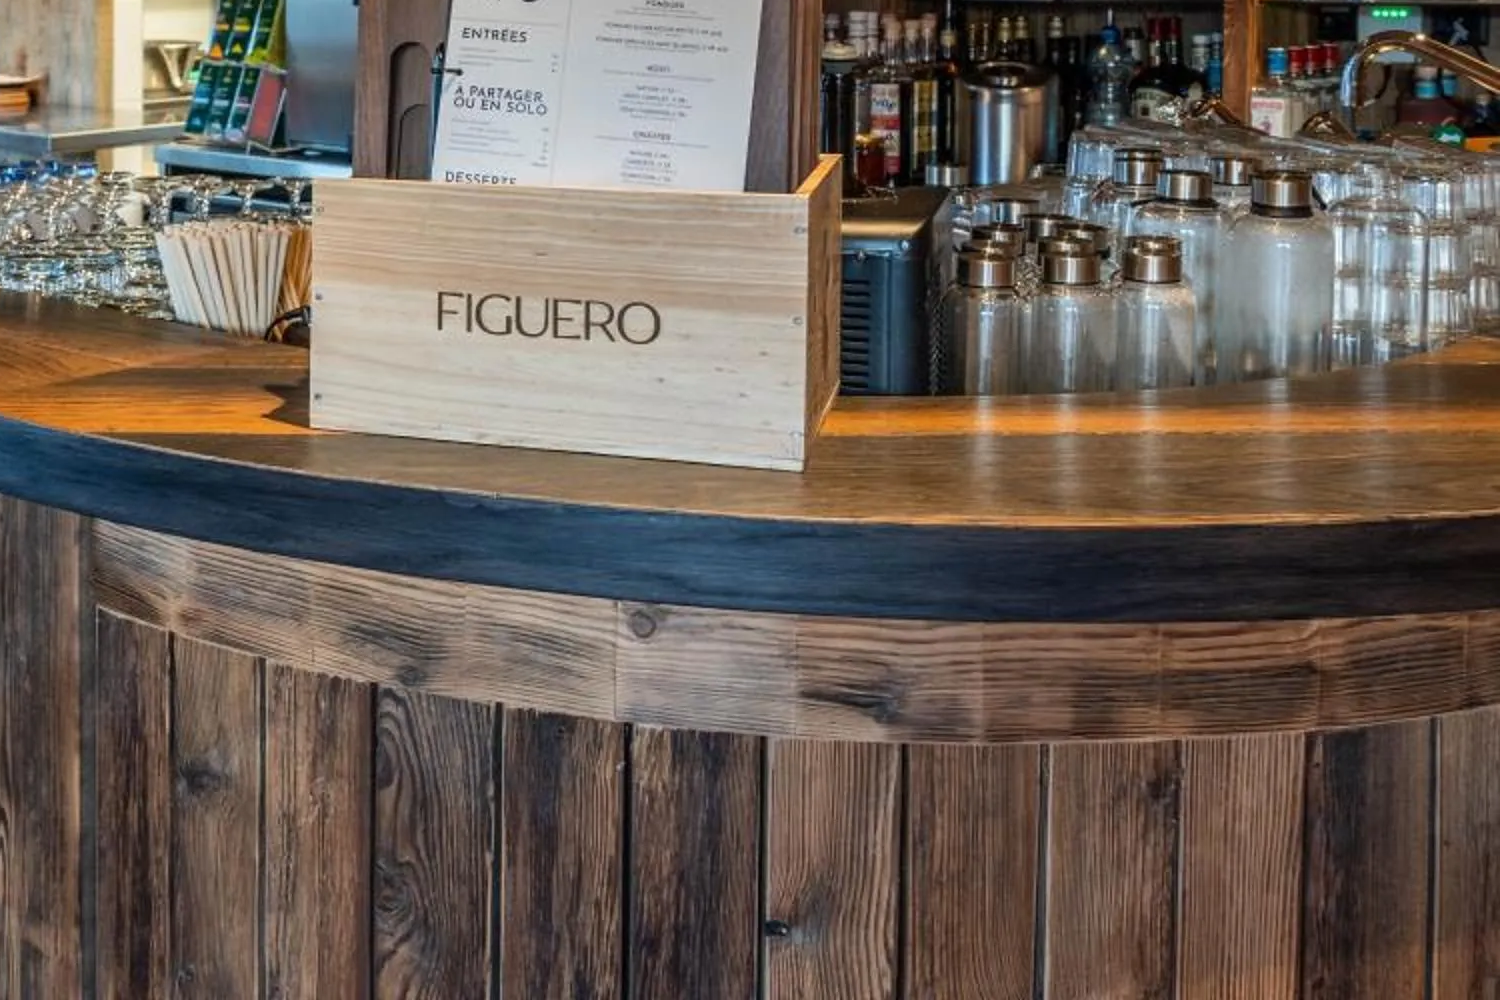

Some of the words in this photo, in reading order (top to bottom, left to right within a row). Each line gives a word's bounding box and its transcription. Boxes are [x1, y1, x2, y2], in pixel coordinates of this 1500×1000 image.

[469, 85, 543, 102] PARTAGER
[453, 97, 475, 109] OU
[480, 99, 501, 111] EN
[506, 101, 548, 116] SOLO
[437, 290, 661, 345] FIGUERO
